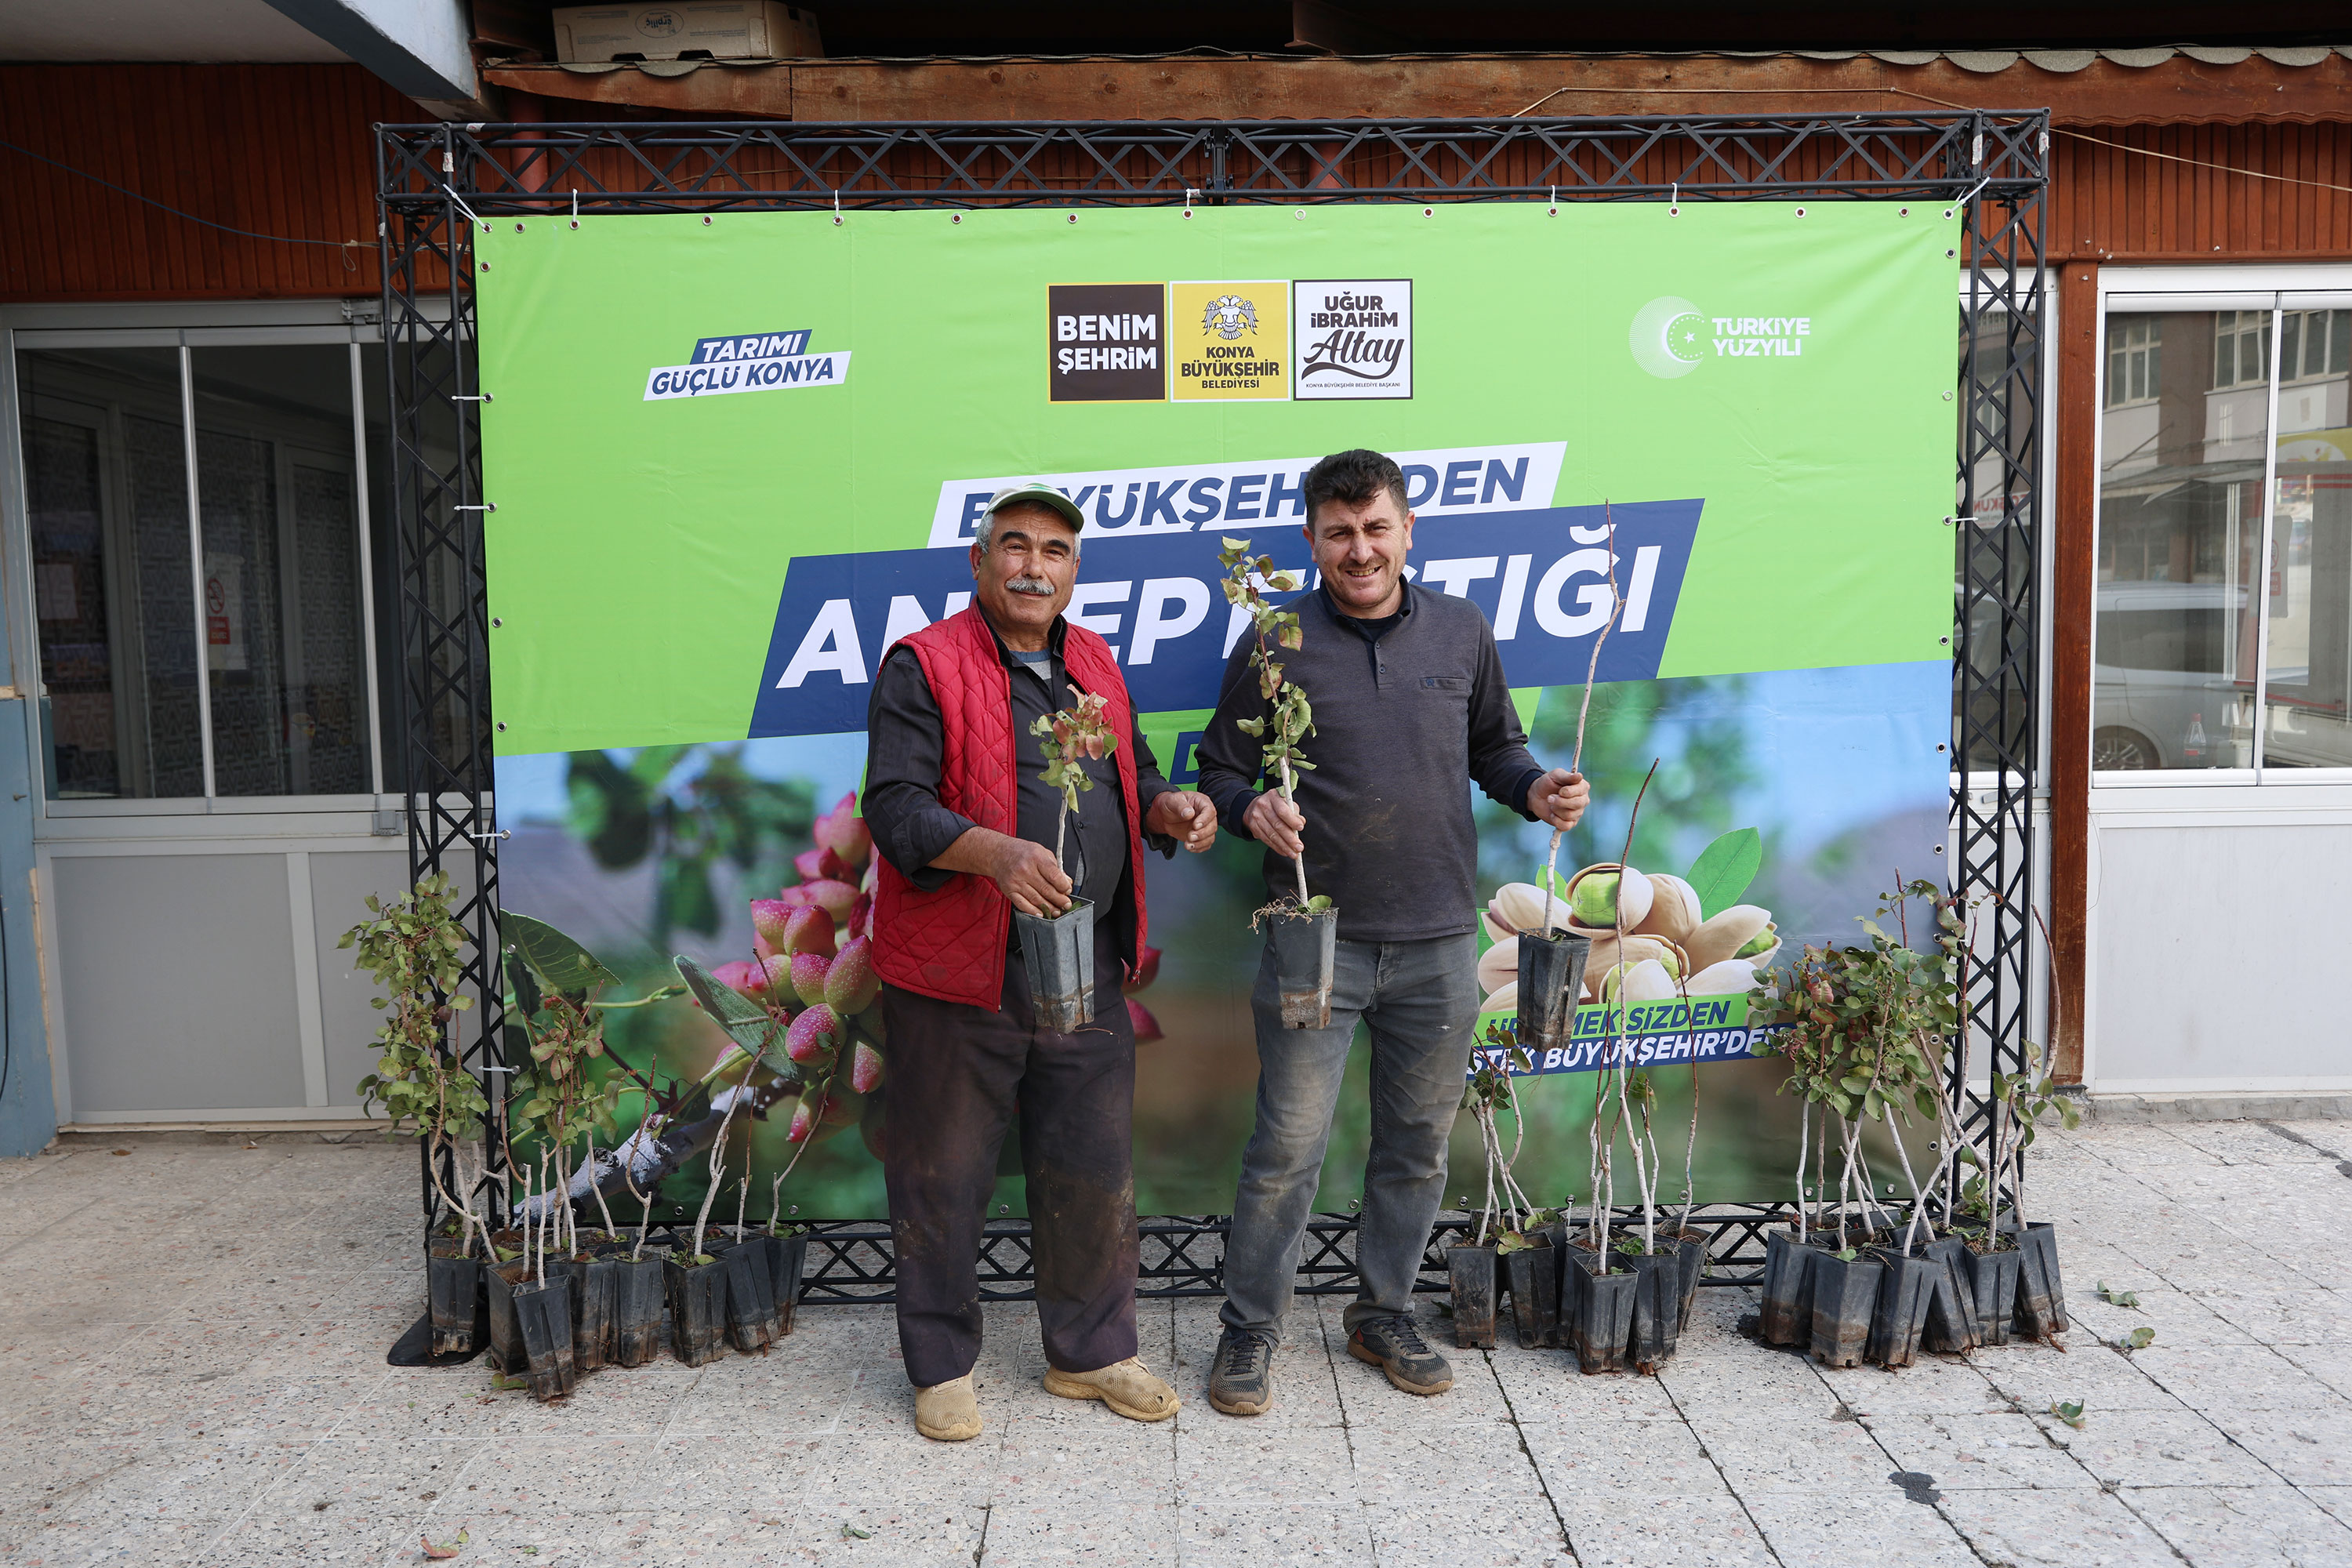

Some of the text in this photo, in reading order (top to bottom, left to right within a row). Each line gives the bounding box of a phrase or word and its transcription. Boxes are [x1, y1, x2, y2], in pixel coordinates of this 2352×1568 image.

[1324, 291, 1384, 311] UĞUR
[1057, 314, 1156, 342] BENİM
[1310, 312, 1398, 328] İBRAHİM
[1711, 317, 1810, 336] TÜRKİYE
[702, 332, 803, 363] TARIMI
[1206, 346, 1255, 359] KONYA
[1301, 328, 1405, 380] Altay
[1711, 338, 1802, 357] YÜZYILI
[1057, 347, 1157, 376] ŞEHRİM
[1181, 358, 1279, 379] BÜYÜKŞEHİR
[652, 357, 833, 397] GÜÇLÜ KONYA
[1201, 377, 1260, 390] BELEDİYESİ
[1626, 1000, 1731, 1032] SİZDEN
